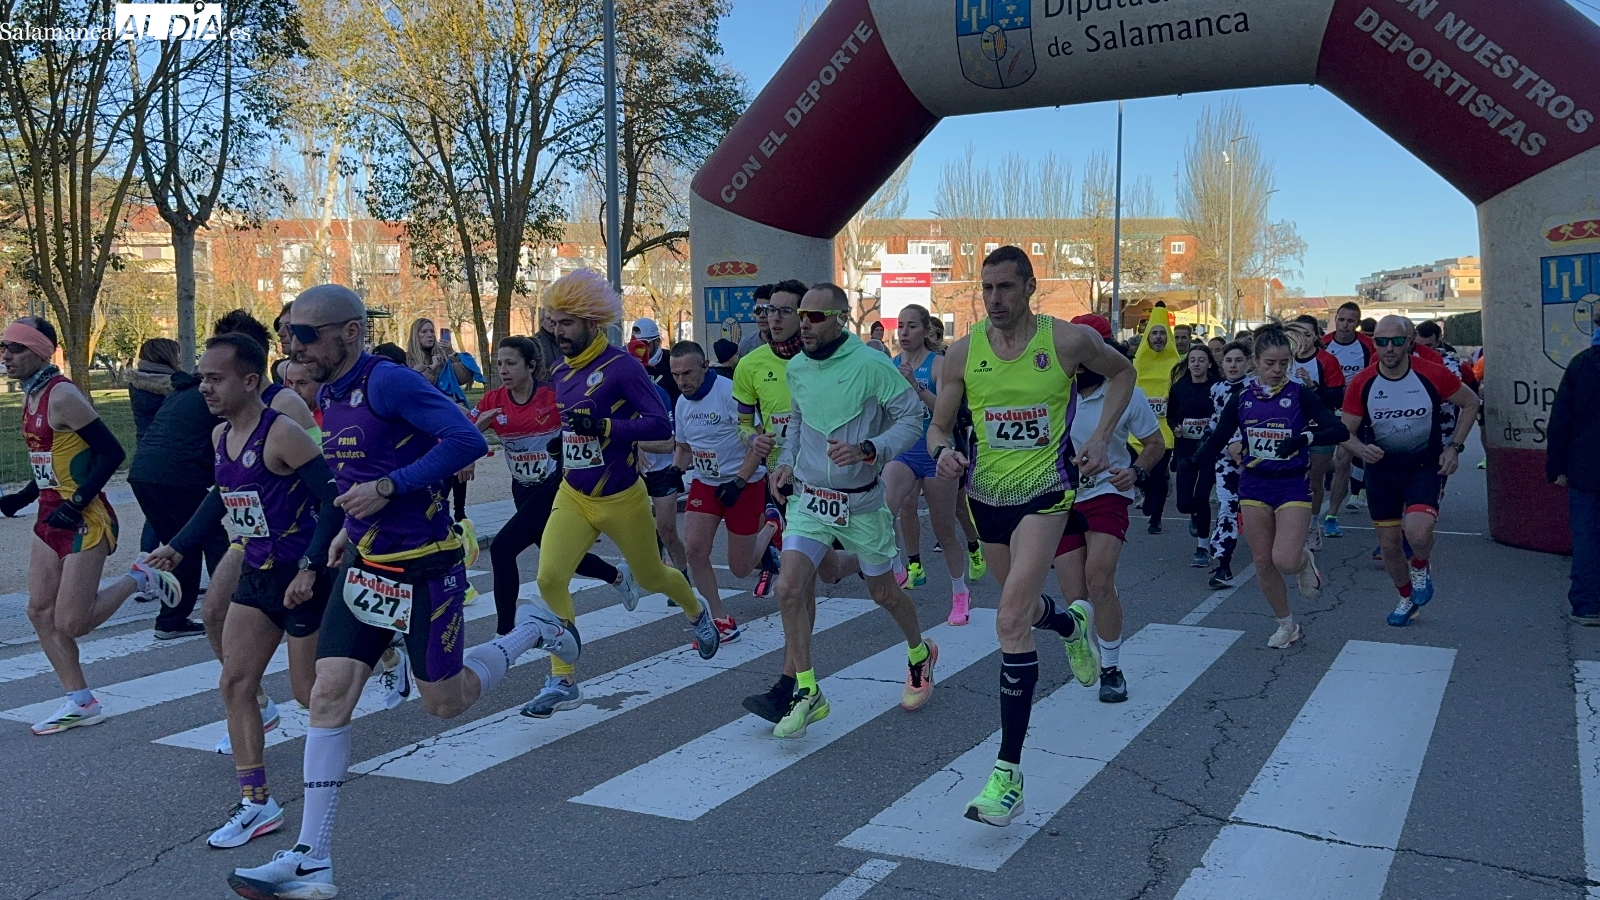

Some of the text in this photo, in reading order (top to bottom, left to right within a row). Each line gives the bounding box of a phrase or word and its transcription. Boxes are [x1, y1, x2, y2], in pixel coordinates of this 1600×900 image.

[1047, 12, 1250, 58] de Salamanca
[1354, 7, 1547, 156] DEPORTISTAS
[1434, 11, 1594, 134] NUESTROS
[720, 20, 874, 203] CON EL DEPORTE
[984, 407, 1047, 421] bedunia
[1373, 408, 1427, 420] 37300
[996, 420, 1040, 441] 425
[1504, 418, 1551, 444] de S
[566, 443, 593, 461] 426
[34, 464, 50, 481] 54
[515, 461, 542, 475] 414
[806, 496, 841, 518] 400
[347, 570, 411, 600] bedunia
[353, 588, 401, 618] 427
